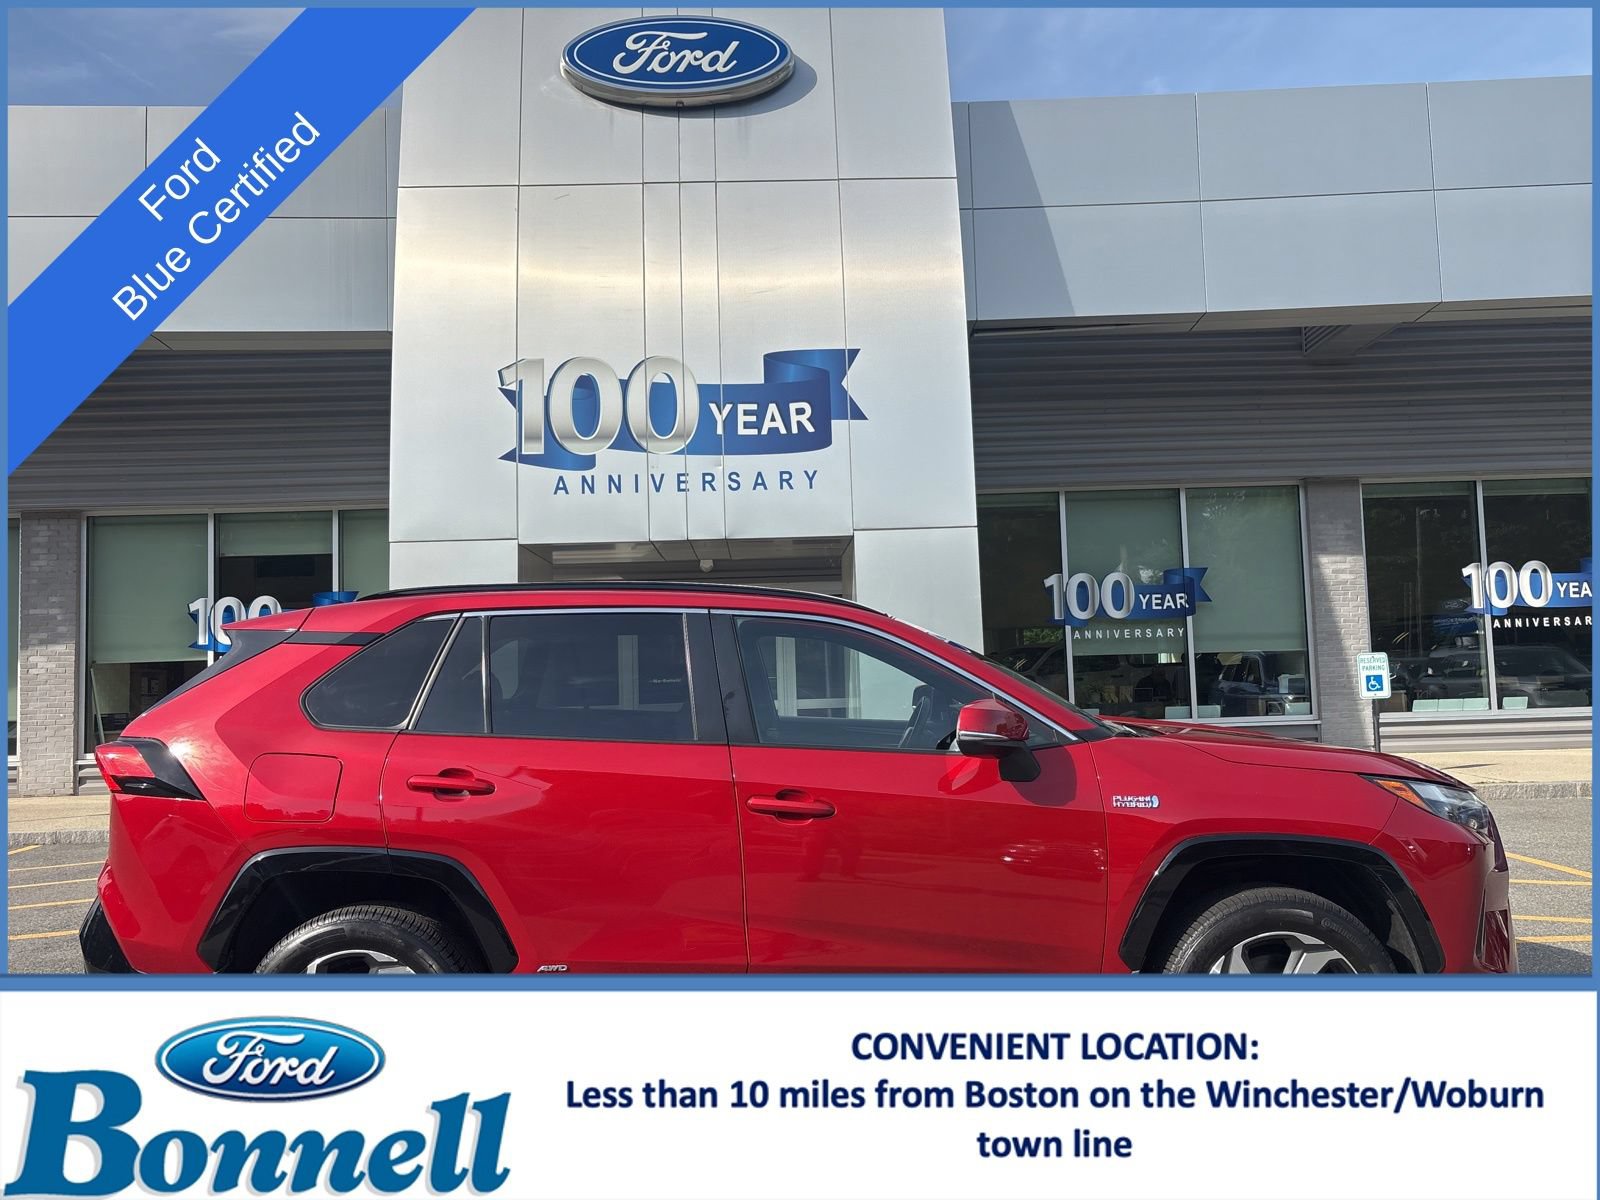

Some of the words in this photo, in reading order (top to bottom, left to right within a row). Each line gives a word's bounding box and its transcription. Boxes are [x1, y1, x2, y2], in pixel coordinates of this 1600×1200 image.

[612, 30, 741, 75] Ford
[497, 355, 700, 456] 100
[708, 401, 816, 436] YEAR
[553, 470, 819, 496] ANNIVERSARY
[1043, 571, 1136, 620] 100
[1138, 592, 1190, 610] YEAR
[1461, 560, 1553, 609] 100
[1556, 581, 1592, 598] YEA
[1073, 626, 1186, 640] ANNIVERSARY
[1493, 615, 1592, 629] ANNIVERSAR
